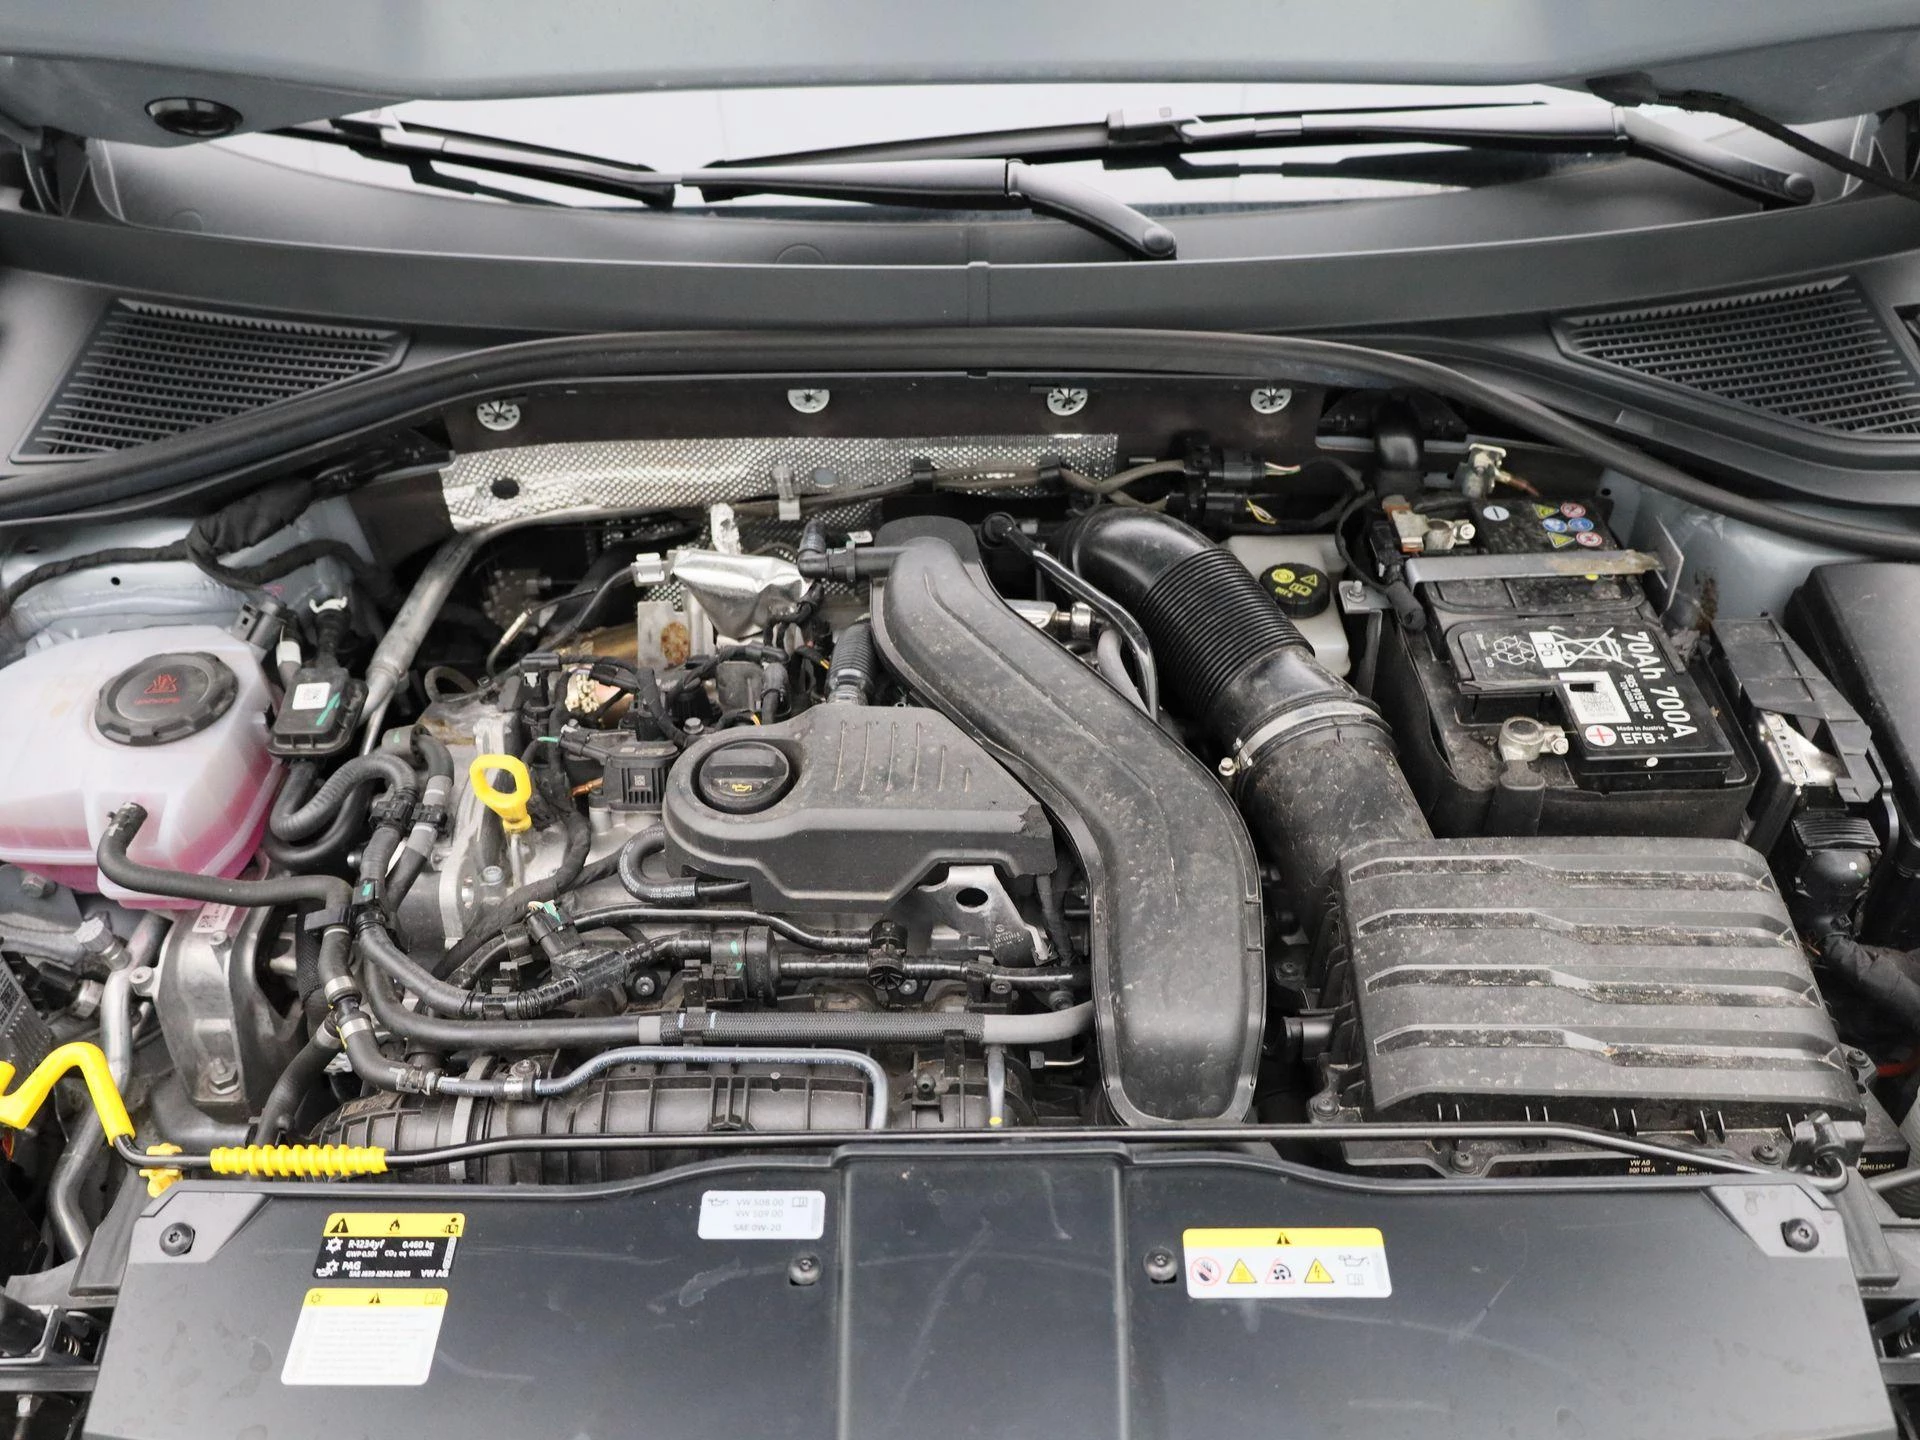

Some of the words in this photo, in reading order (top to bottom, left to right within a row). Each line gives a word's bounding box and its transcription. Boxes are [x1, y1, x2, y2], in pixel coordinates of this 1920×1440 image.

[1621, 631, 1667, 680] 70Ah
[1649, 685, 1698, 739] 700A
[1620, 732, 1656, 745] EFB
[1657, 734, 1669, 743] +
[736, 1198, 751, 1206] VW
[753, 1198, 770, 1206] 508
[735, 1209, 750, 1217] VW
[733, 1224, 750, 1232] SAE
[751, 1223, 782, 1232] 0W-20
[347, 1239, 386, 1251] R-1234yf
[425, 1240, 435, 1251] kg
[341, 1261, 362, 1271] PAG
[420, 1269, 437, 1278] VW
[437, 1269, 449, 1278] AG
